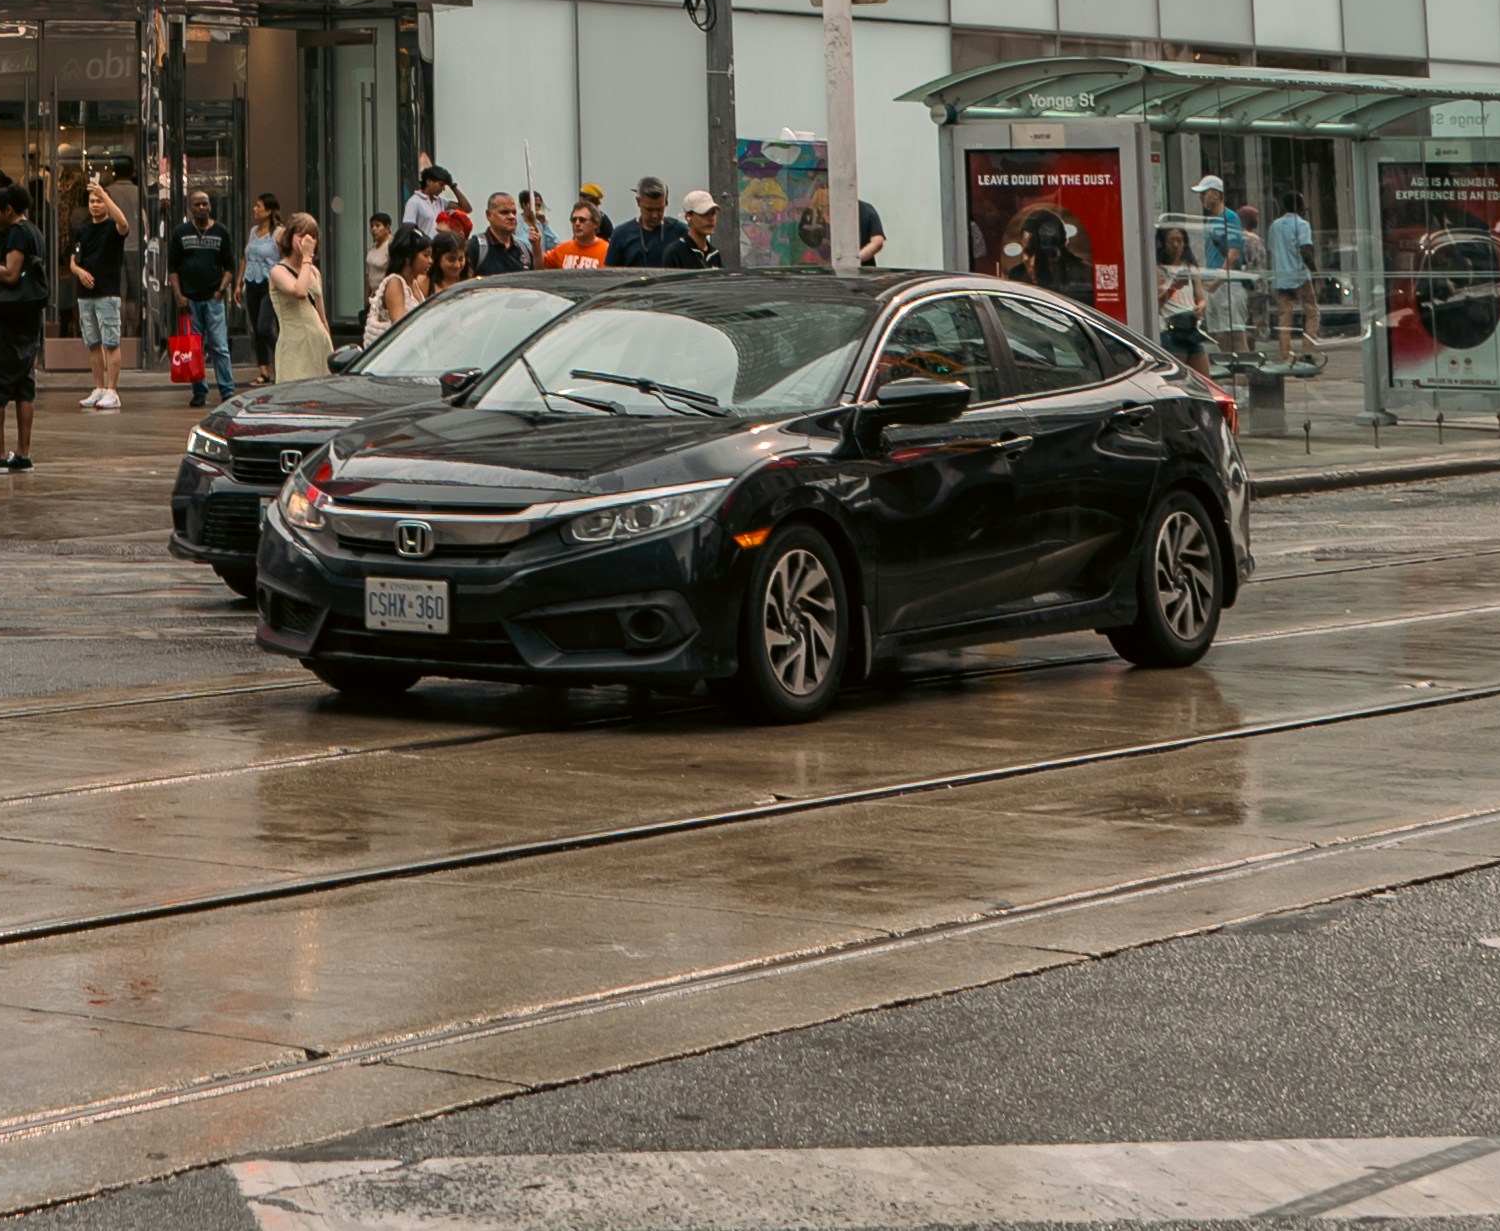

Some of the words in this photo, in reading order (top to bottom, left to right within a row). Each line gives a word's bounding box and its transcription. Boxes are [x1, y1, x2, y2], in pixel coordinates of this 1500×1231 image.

[1028, 93, 1074, 110] Yonge
[1078, 92, 1096, 107] St
[977, 174, 1010, 186] LEAVE
[1011, 174, 1045, 186] DOUBT
[1047, 174, 1059, 186] IN
[1061, 174, 1081, 186] THE
[1083, 174, 1114, 186] DUST.
[1431, 177, 1442, 187] IS
[1444, 177, 1451, 187] A
[1453, 177, 1499, 187] NUMBER.
[1395, 190, 1456, 201] EXPERIENCE
[1457, 190, 1466, 201] IS
[1469, 190, 1485, 201] AN
[368, 591, 407, 618] CSHX
[415, 594, 445, 620] 360
